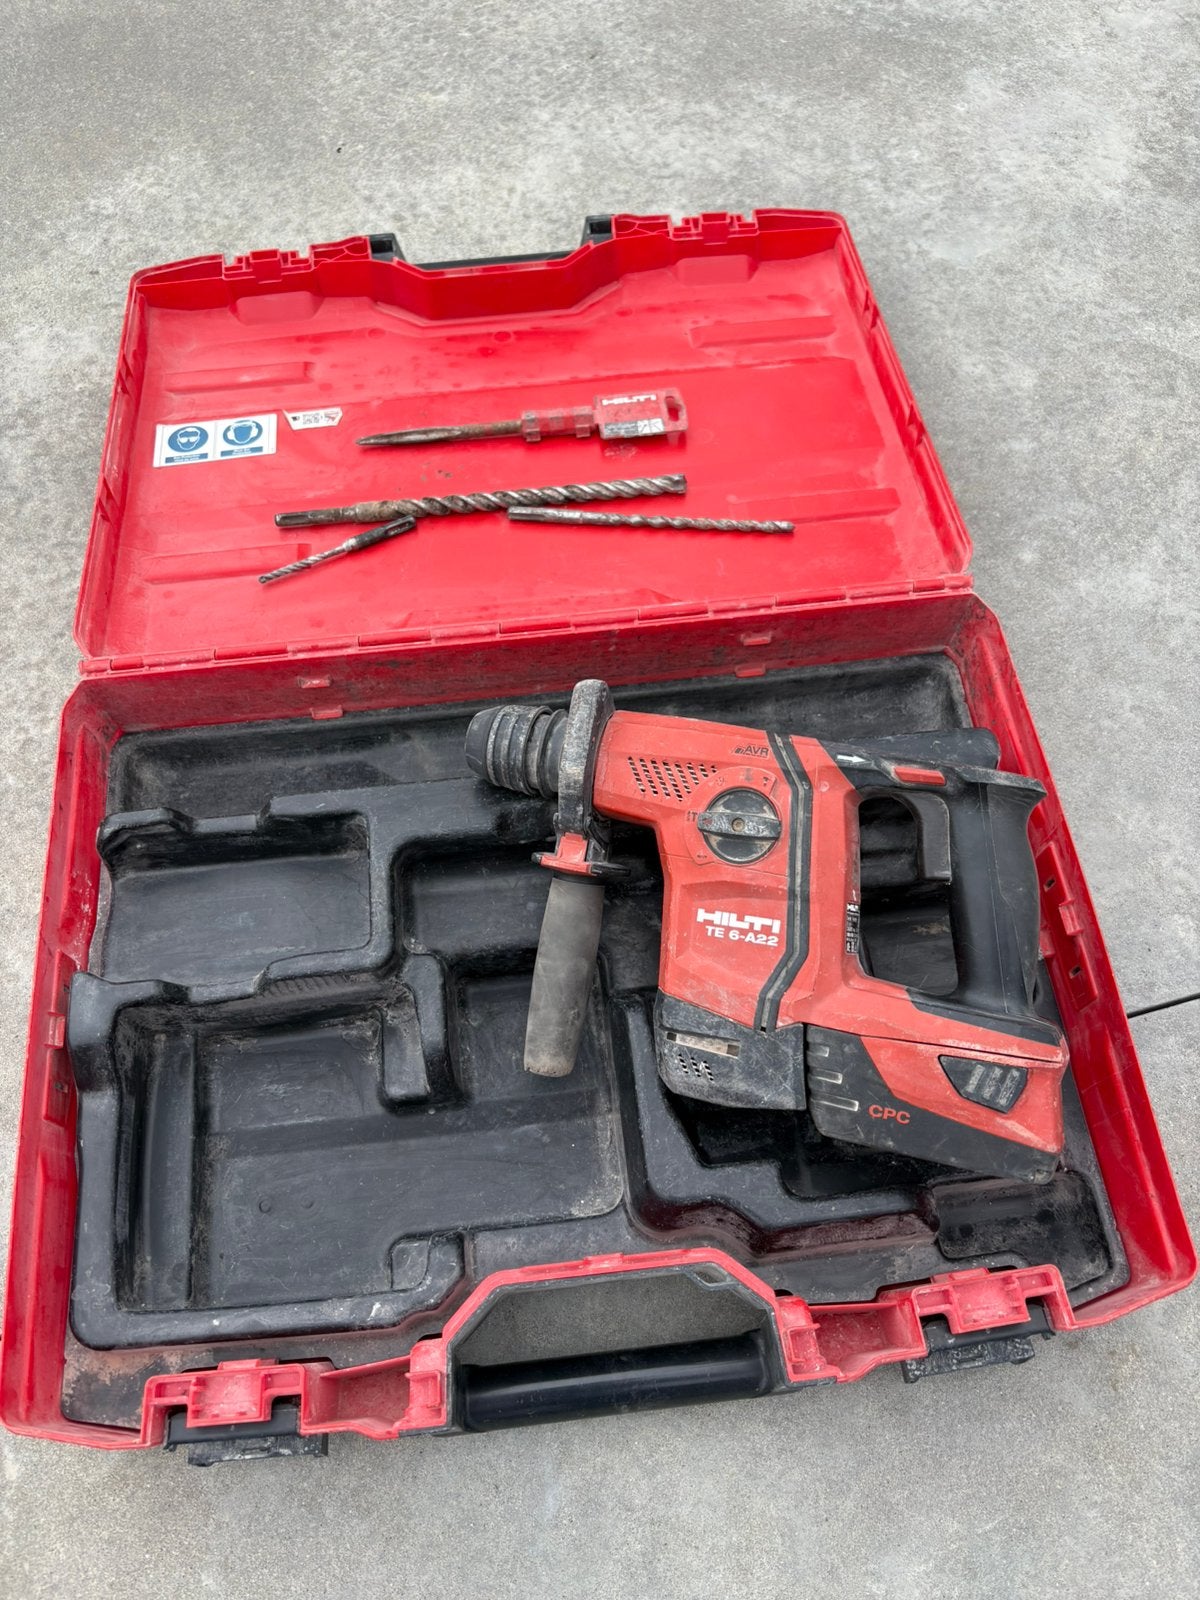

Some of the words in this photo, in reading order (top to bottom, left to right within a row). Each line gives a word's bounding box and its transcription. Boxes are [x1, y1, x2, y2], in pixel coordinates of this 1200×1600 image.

[745, 745, 769, 756] AVR
[696, 908, 780, 934] HILTI
[705, 925, 725, 938] TE
[728, 929, 778, 947] 6-A22
[868, 1104, 910, 1124] CPC
